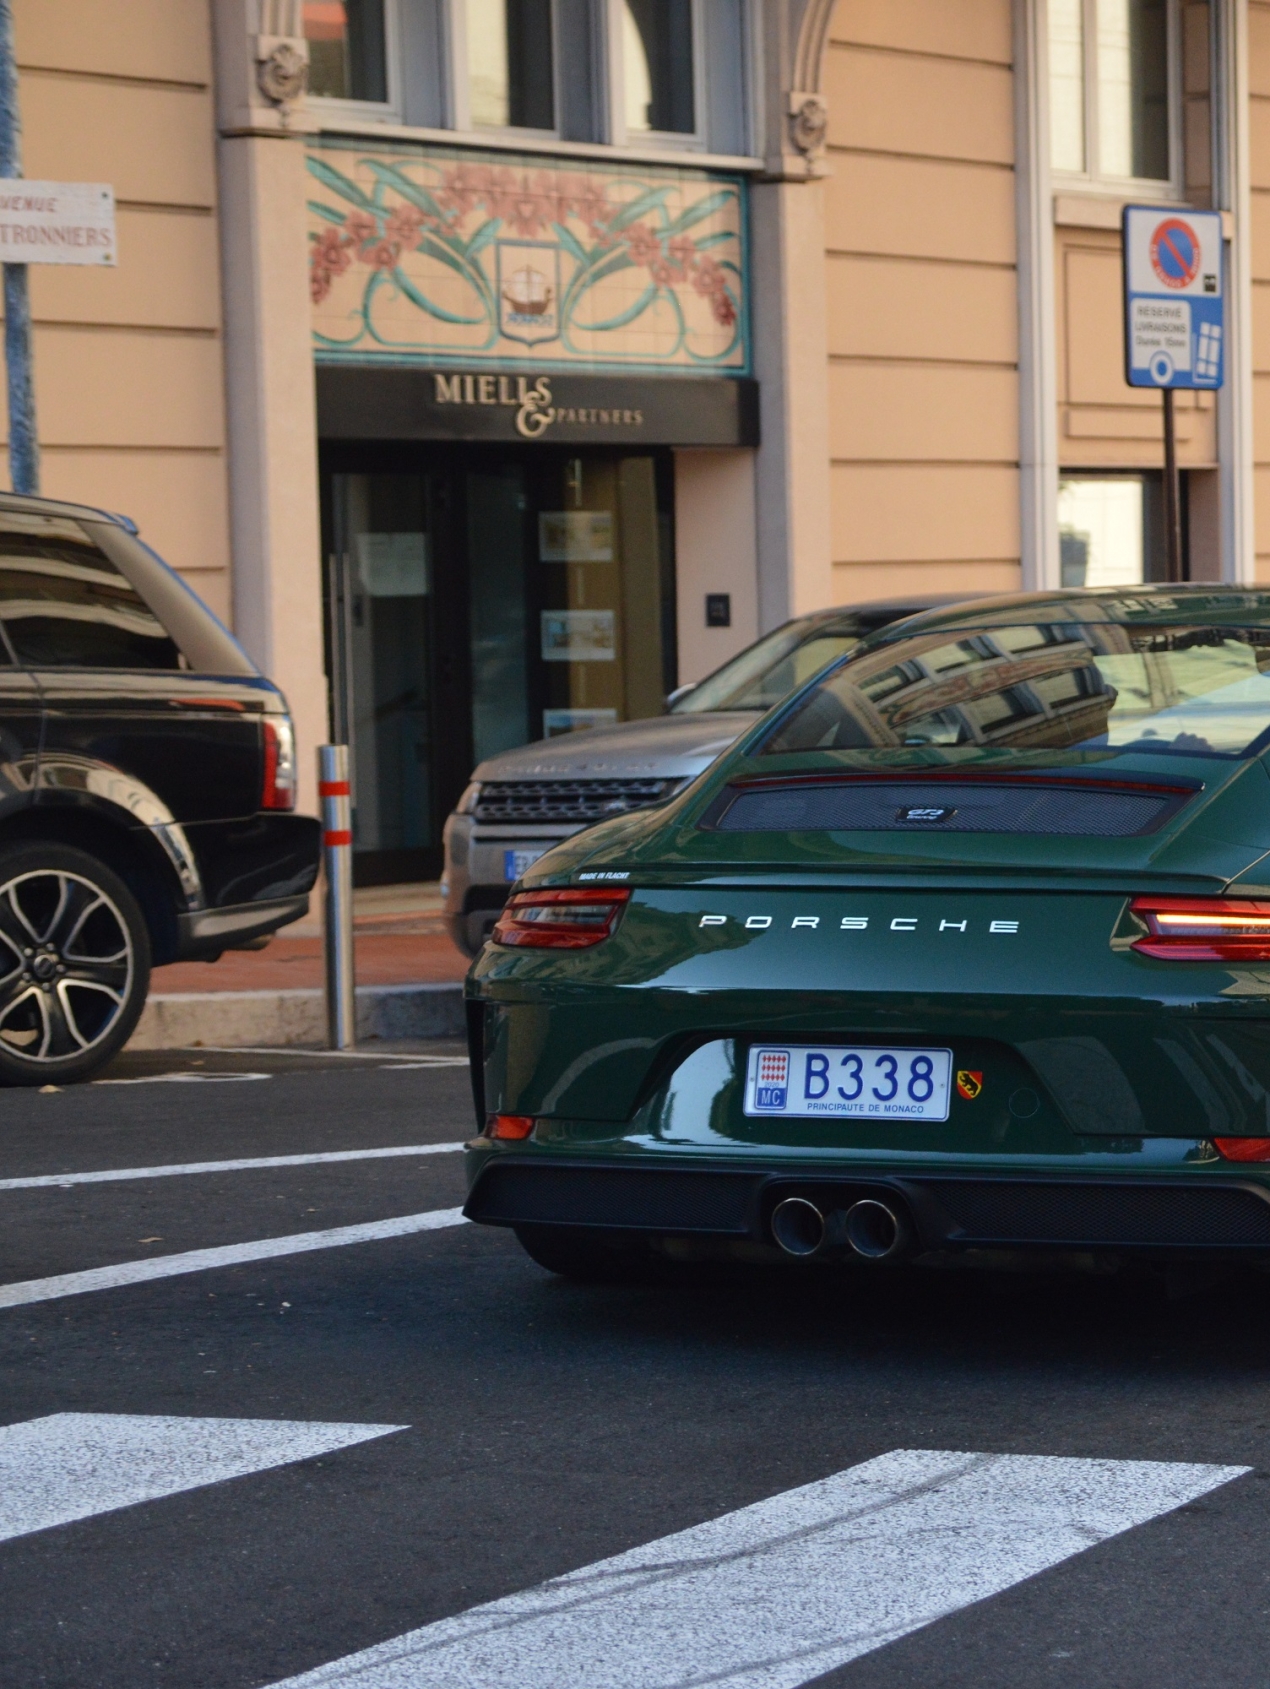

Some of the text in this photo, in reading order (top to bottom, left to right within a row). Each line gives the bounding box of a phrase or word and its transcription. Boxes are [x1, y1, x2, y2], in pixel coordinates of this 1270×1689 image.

[1134, 320, 1187, 334] LIVRAISONS
[557, 408, 643, 426] PARTNERS
[579, 872, 598, 880] MADE
[699, 915, 1020, 933] PORSCHE
[804, 1053, 934, 1103] B338
[761, 1090, 780, 1105] MC
[807, 1102, 924, 1113] PRINCIPAUTE DE MONACO
